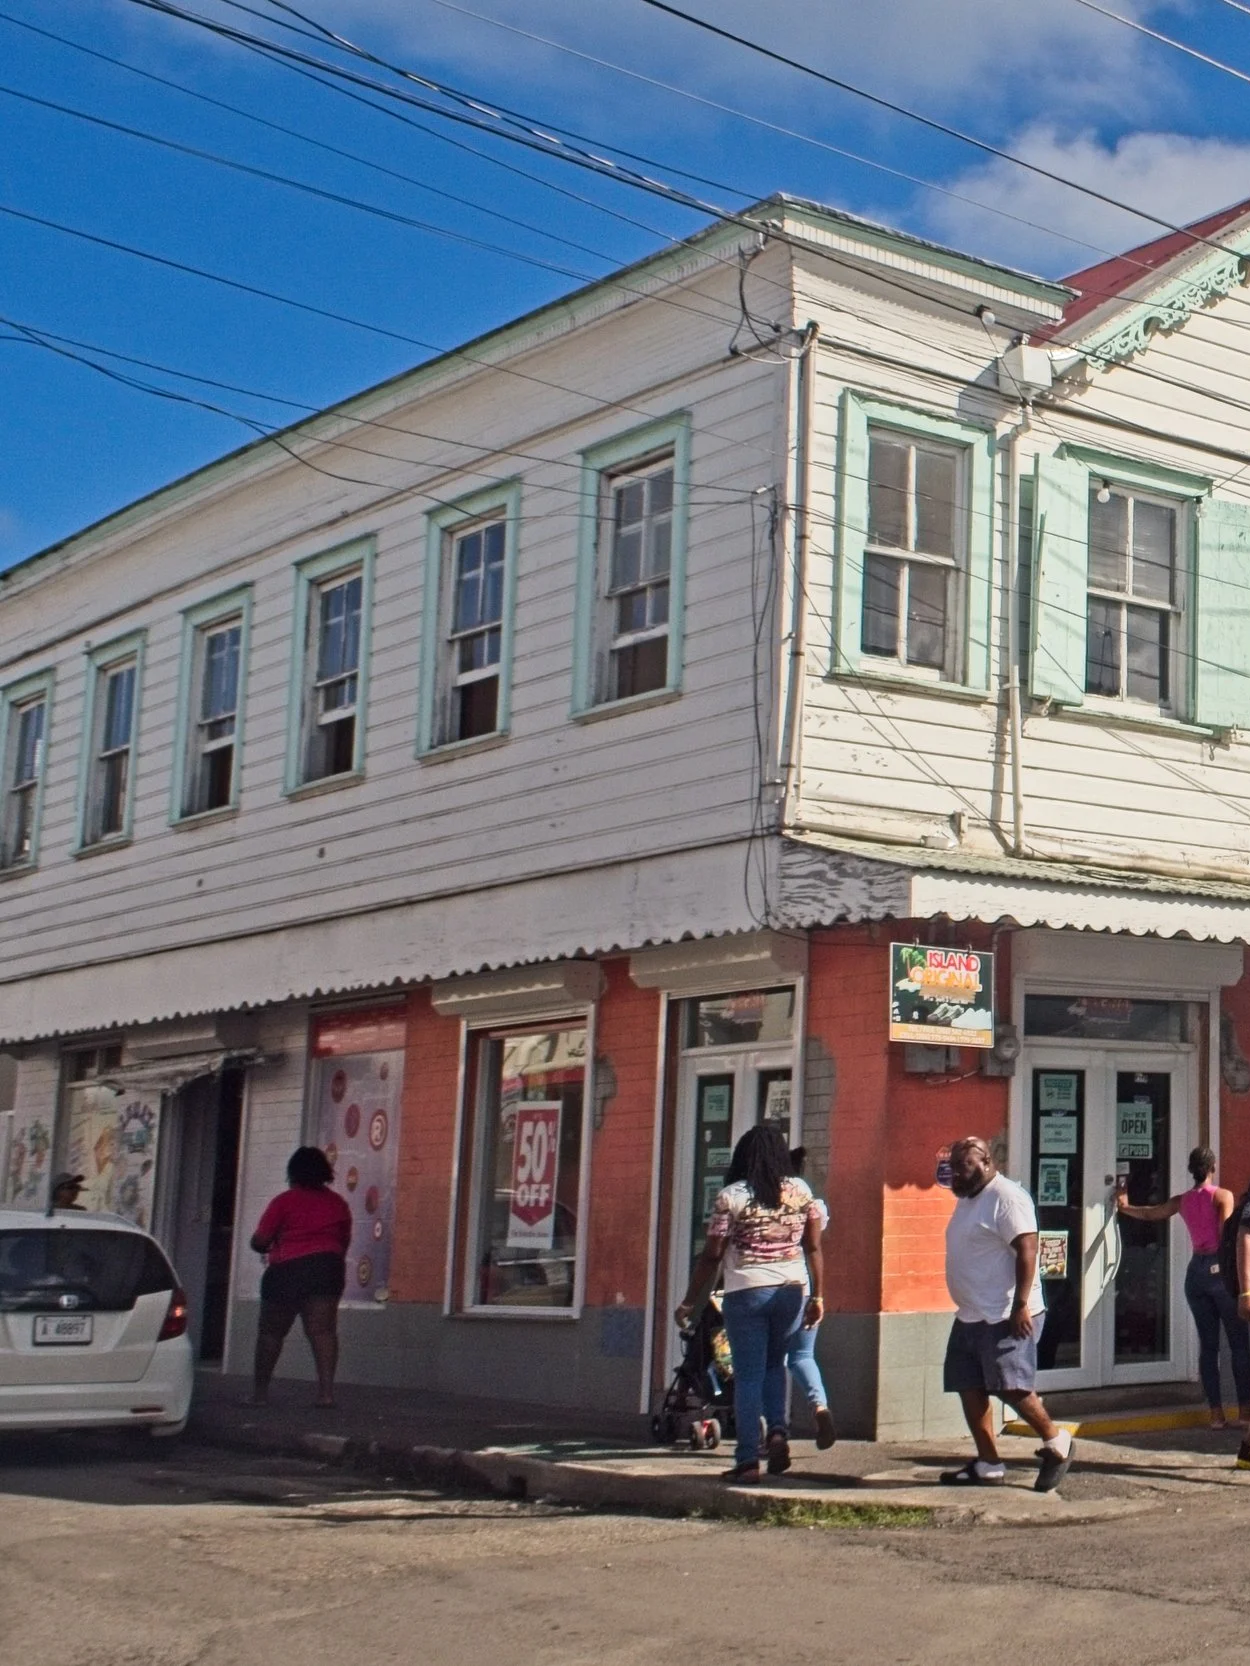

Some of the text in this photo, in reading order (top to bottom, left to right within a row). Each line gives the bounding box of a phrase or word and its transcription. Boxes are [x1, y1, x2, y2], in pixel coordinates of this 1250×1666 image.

[928, 951, 980, 973] ISLAND
[910, 966, 982, 990] ORIGINAL
[1121, 1119, 1147, 1134] OPEN
[1129, 1144, 1149, 1156] PUSH
[517, 1184, 550, 1207] OFF
